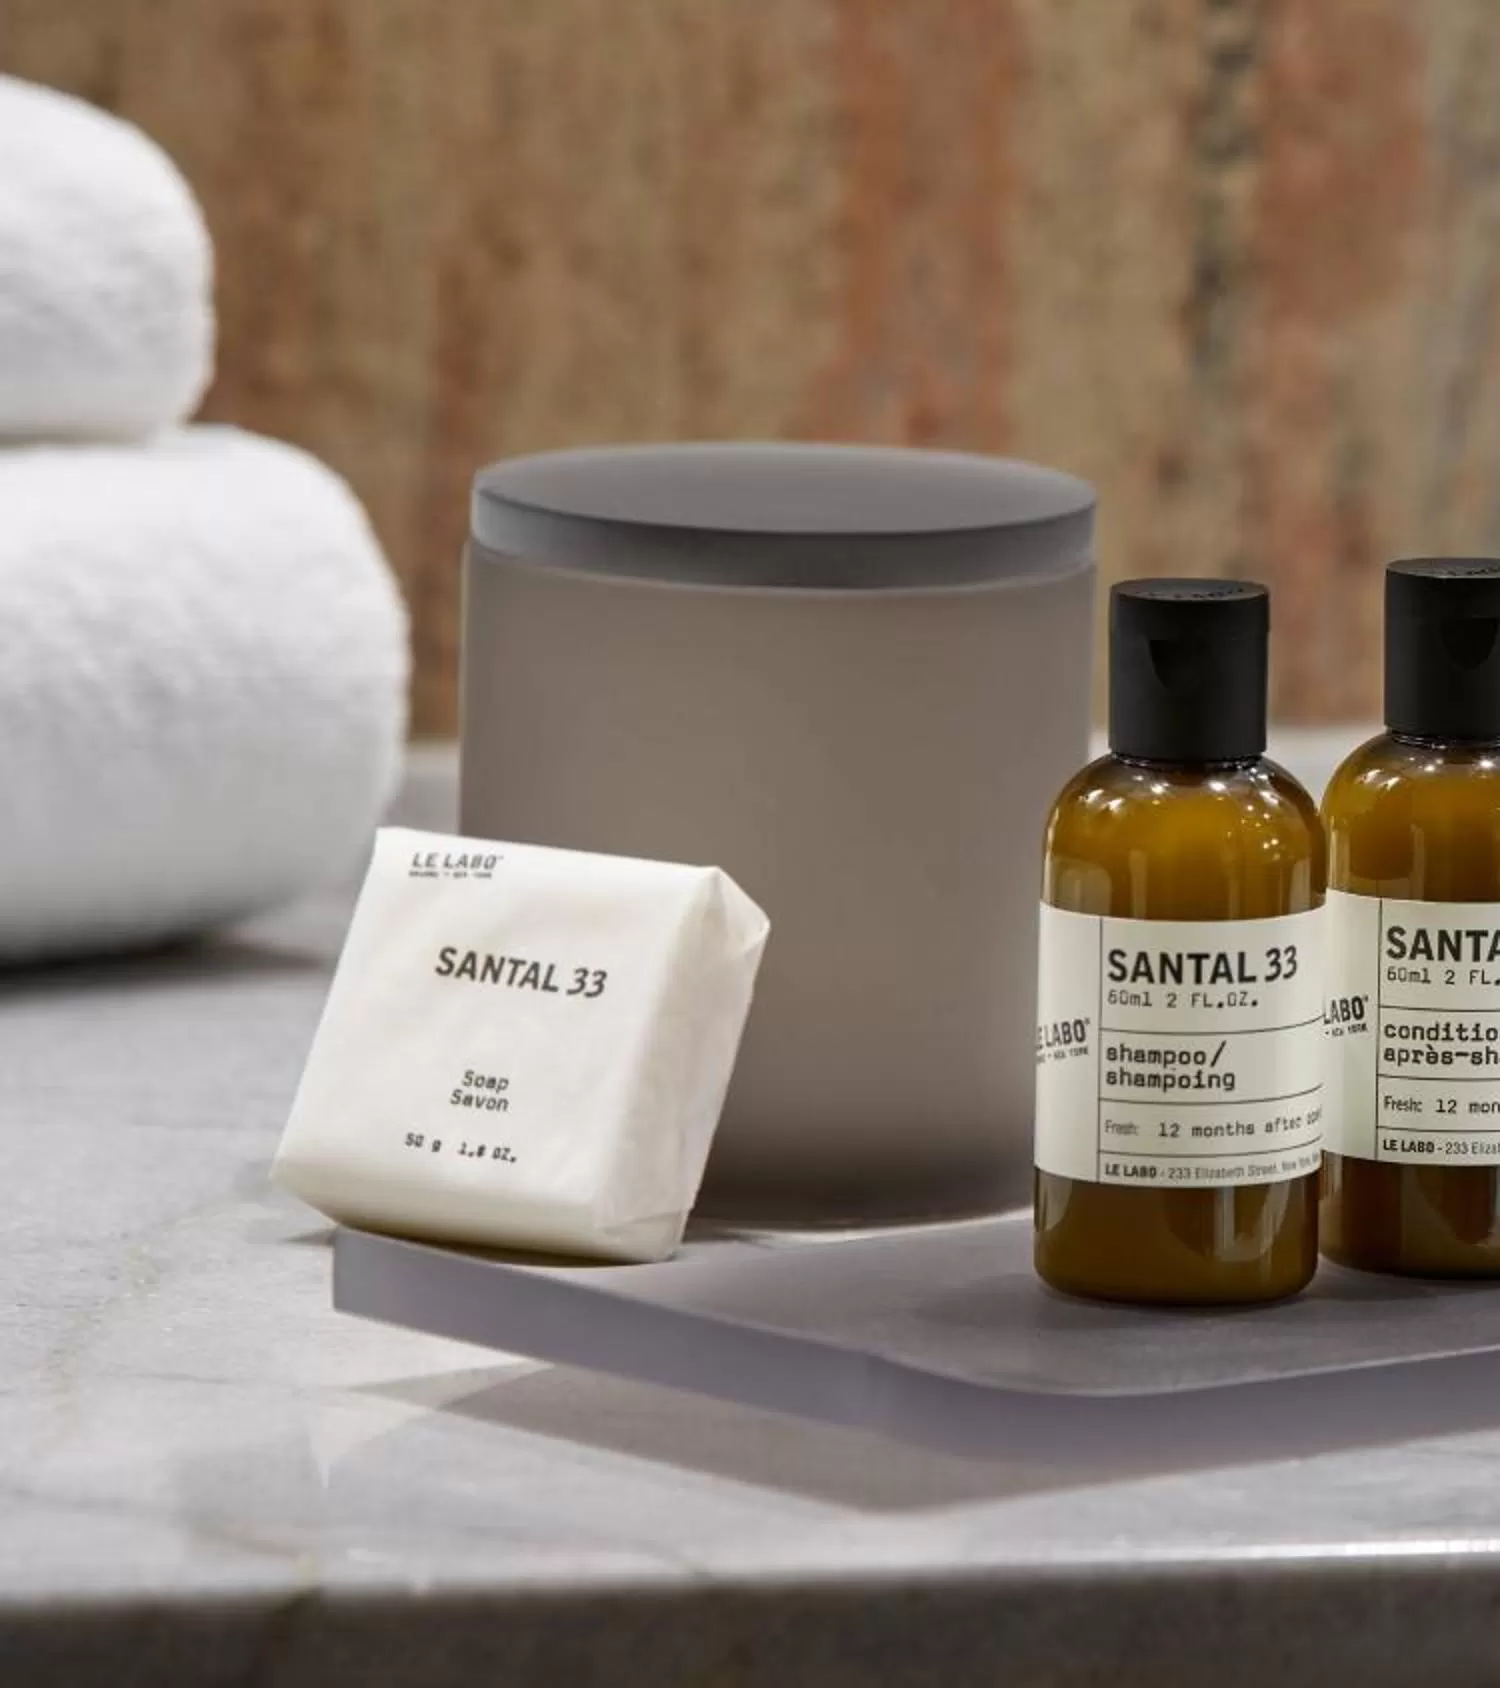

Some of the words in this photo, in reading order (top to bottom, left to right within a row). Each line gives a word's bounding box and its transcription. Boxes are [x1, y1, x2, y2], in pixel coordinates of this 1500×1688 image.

[411, 851, 436, 869] LE
[435, 946, 559, 993] SANTAL
[566, 967, 608, 998] 33
[1108, 948, 1256, 984] SANTAL
[1265, 945, 1298, 983] 33
[1387, 966, 1431, 984] 60ml
[1445, 969, 1455, 985] 2
[1108, 990, 1152, 1007] 60ml
[1166, 992, 1178, 1008] 2
[1190, 992, 1259, 1010] FL.OZ.
[1106, 1041, 1226, 1068] shampoo/
[462, 1069, 510, 1092] Soap
[1106, 1070, 1236, 1092] shampoing
[450, 1088, 510, 1112] Savon
[1436, 1098, 1458, 1114] 12
[1158, 1123, 1180, 1138] 12
[1192, 1122, 1255, 1138] months
[1264, 1116, 1300, 1134] after
[404, 1132, 424, 1148] 50
[1383, 1138, 1399, 1151] LE
[1401, 1139, 1434, 1153] LABO
[1445, 1141, 1468, 1155] 233
[1105, 1163, 1121, 1176] LE
[1123, 1164, 1157, 1178] LABO
[1168, 1166, 1192, 1180] 233
[1196, 1164, 1244, 1178] Elizabeth
